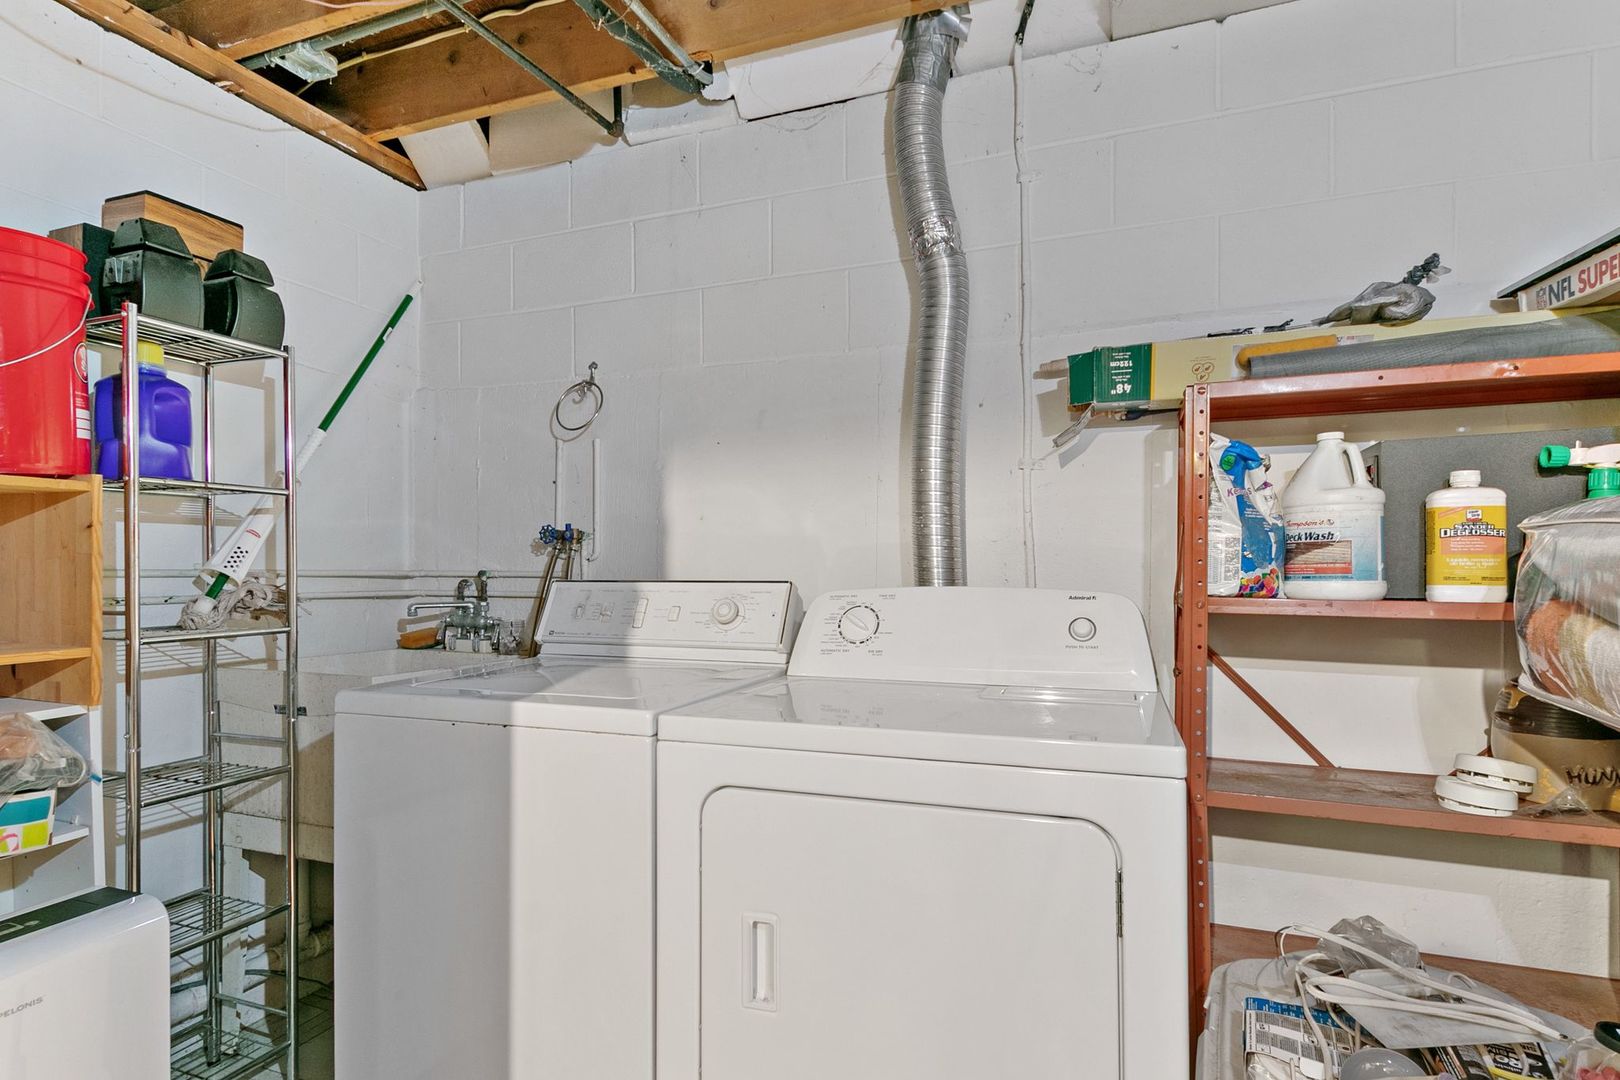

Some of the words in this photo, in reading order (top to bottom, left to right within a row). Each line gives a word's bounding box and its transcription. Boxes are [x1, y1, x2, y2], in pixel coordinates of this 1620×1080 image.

[1548, 275, 1575, 306] NFL
[1577, 253, 1620, 294] SUPE
[1110, 383, 1132, 395] 48"
[1304, 531, 1335, 541] Wash
